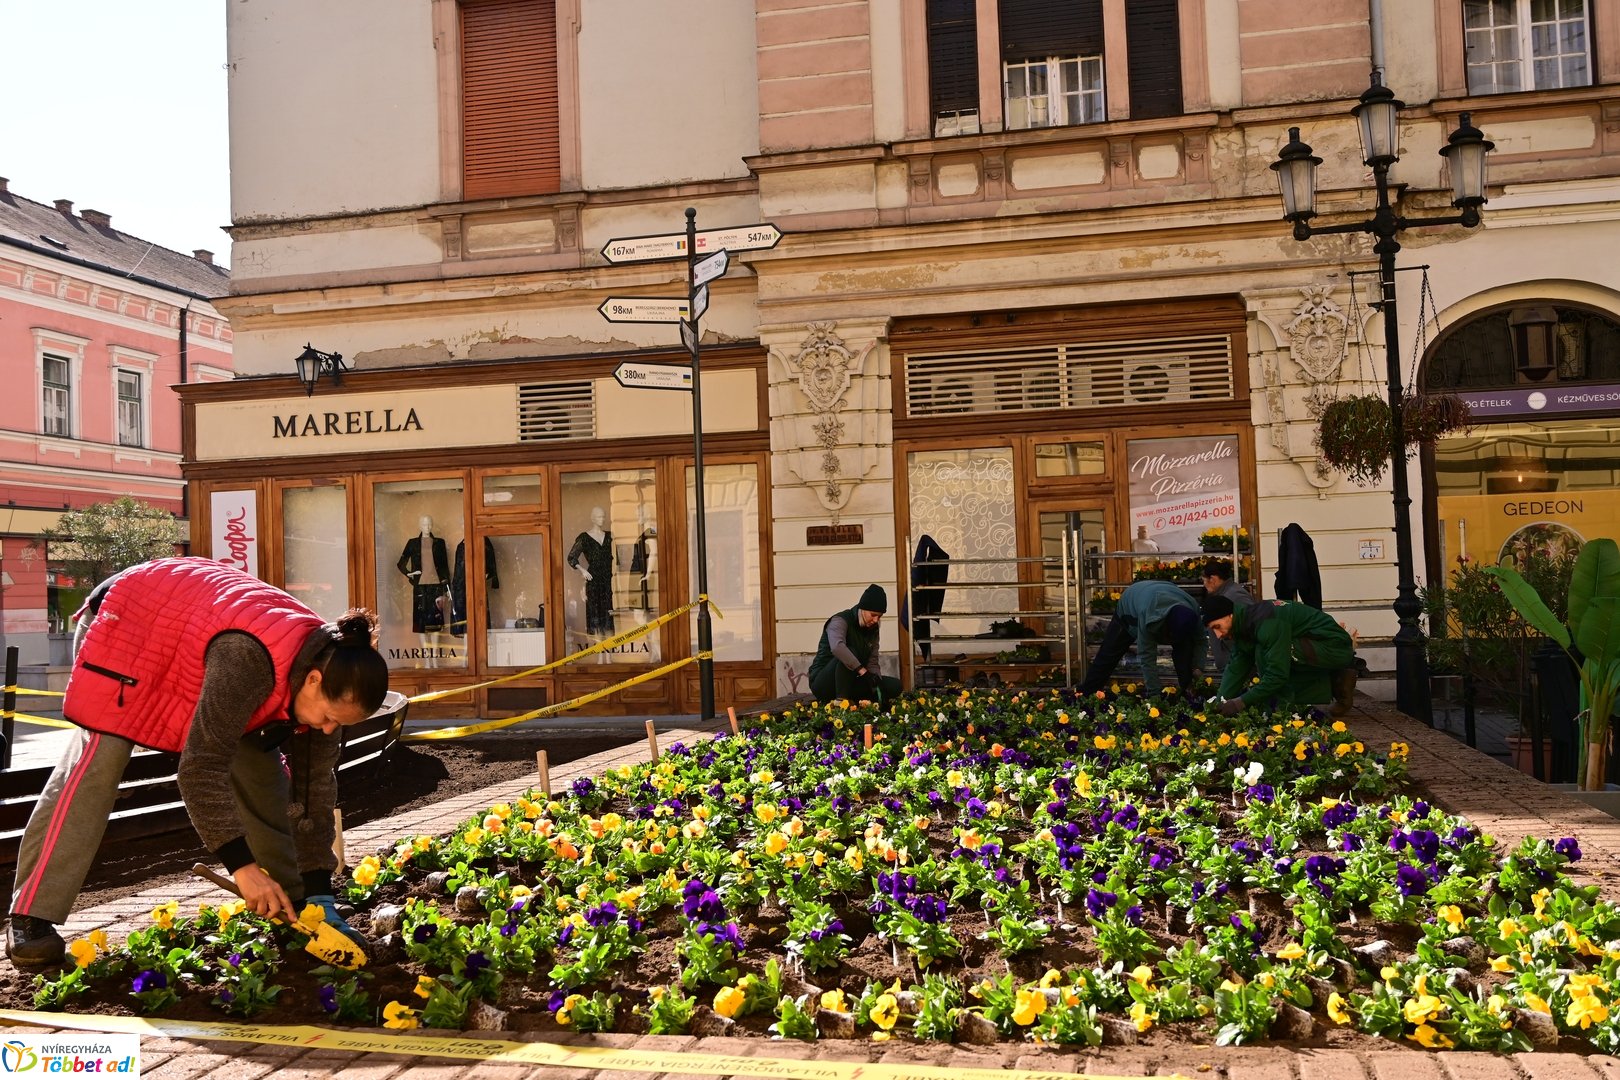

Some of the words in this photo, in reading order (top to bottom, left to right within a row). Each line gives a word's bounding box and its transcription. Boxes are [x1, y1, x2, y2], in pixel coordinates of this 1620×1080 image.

[748, 232, 772, 242] 547KM
[612, 247, 635, 256] 167KM
[612, 306, 632, 315] 98KM
[624, 369, 646, 380] 380KM
[1480, 399, 1512, 408] ÉTELEK
[272, 407, 424, 439] MARELLA
[1131, 441, 1233, 479] Mozzarella
[1150, 473, 1225, 502] Pizzéria
[1136, 495, 1234, 518] www.mozzarellapizzeria.hu
[1503, 500, 1584, 516] GEDEON
[1168, 505, 1235, 526] 42/424-008
[388, 647, 457, 660] MARELLA
[577, 642, 649, 654] MELLA
